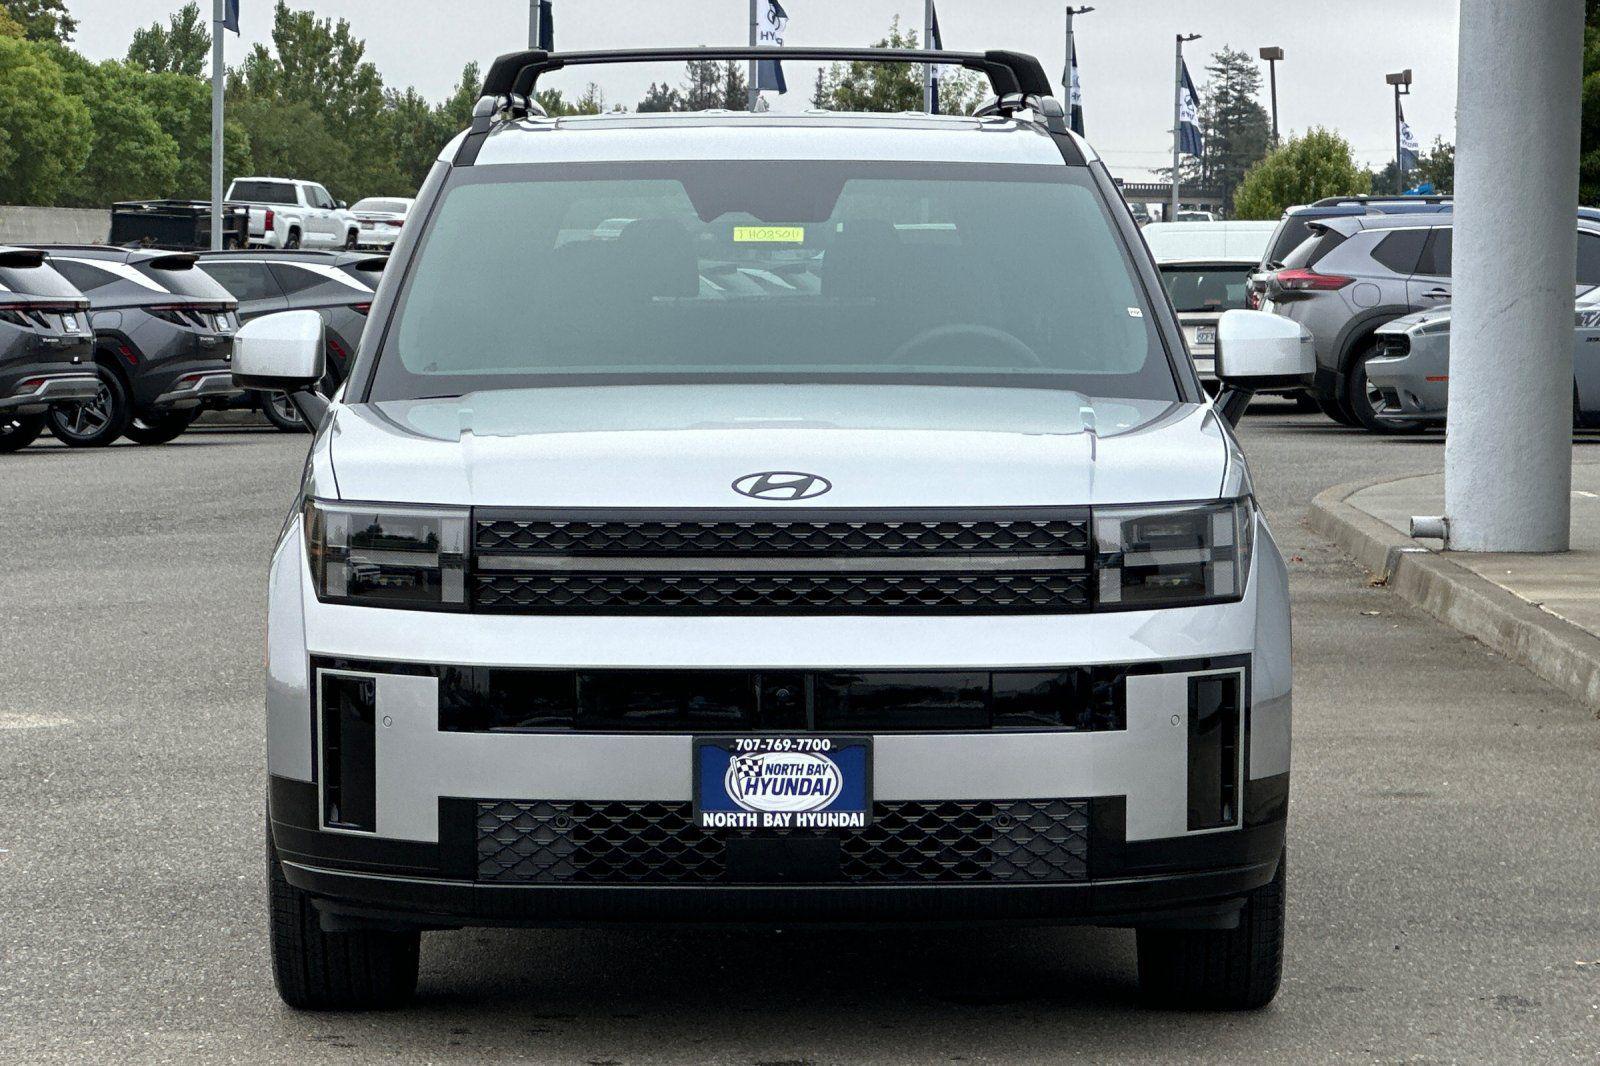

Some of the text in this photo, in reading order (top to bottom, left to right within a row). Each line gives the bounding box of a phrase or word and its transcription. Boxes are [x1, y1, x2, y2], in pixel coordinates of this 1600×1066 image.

[735, 738, 831, 751] 707-769-7700
[764, 763, 830, 776] NORTH BAY
[744, 777, 832, 796] HYUNDAI
[702, 812, 865, 827] NORTH BAY HYUNDAI
